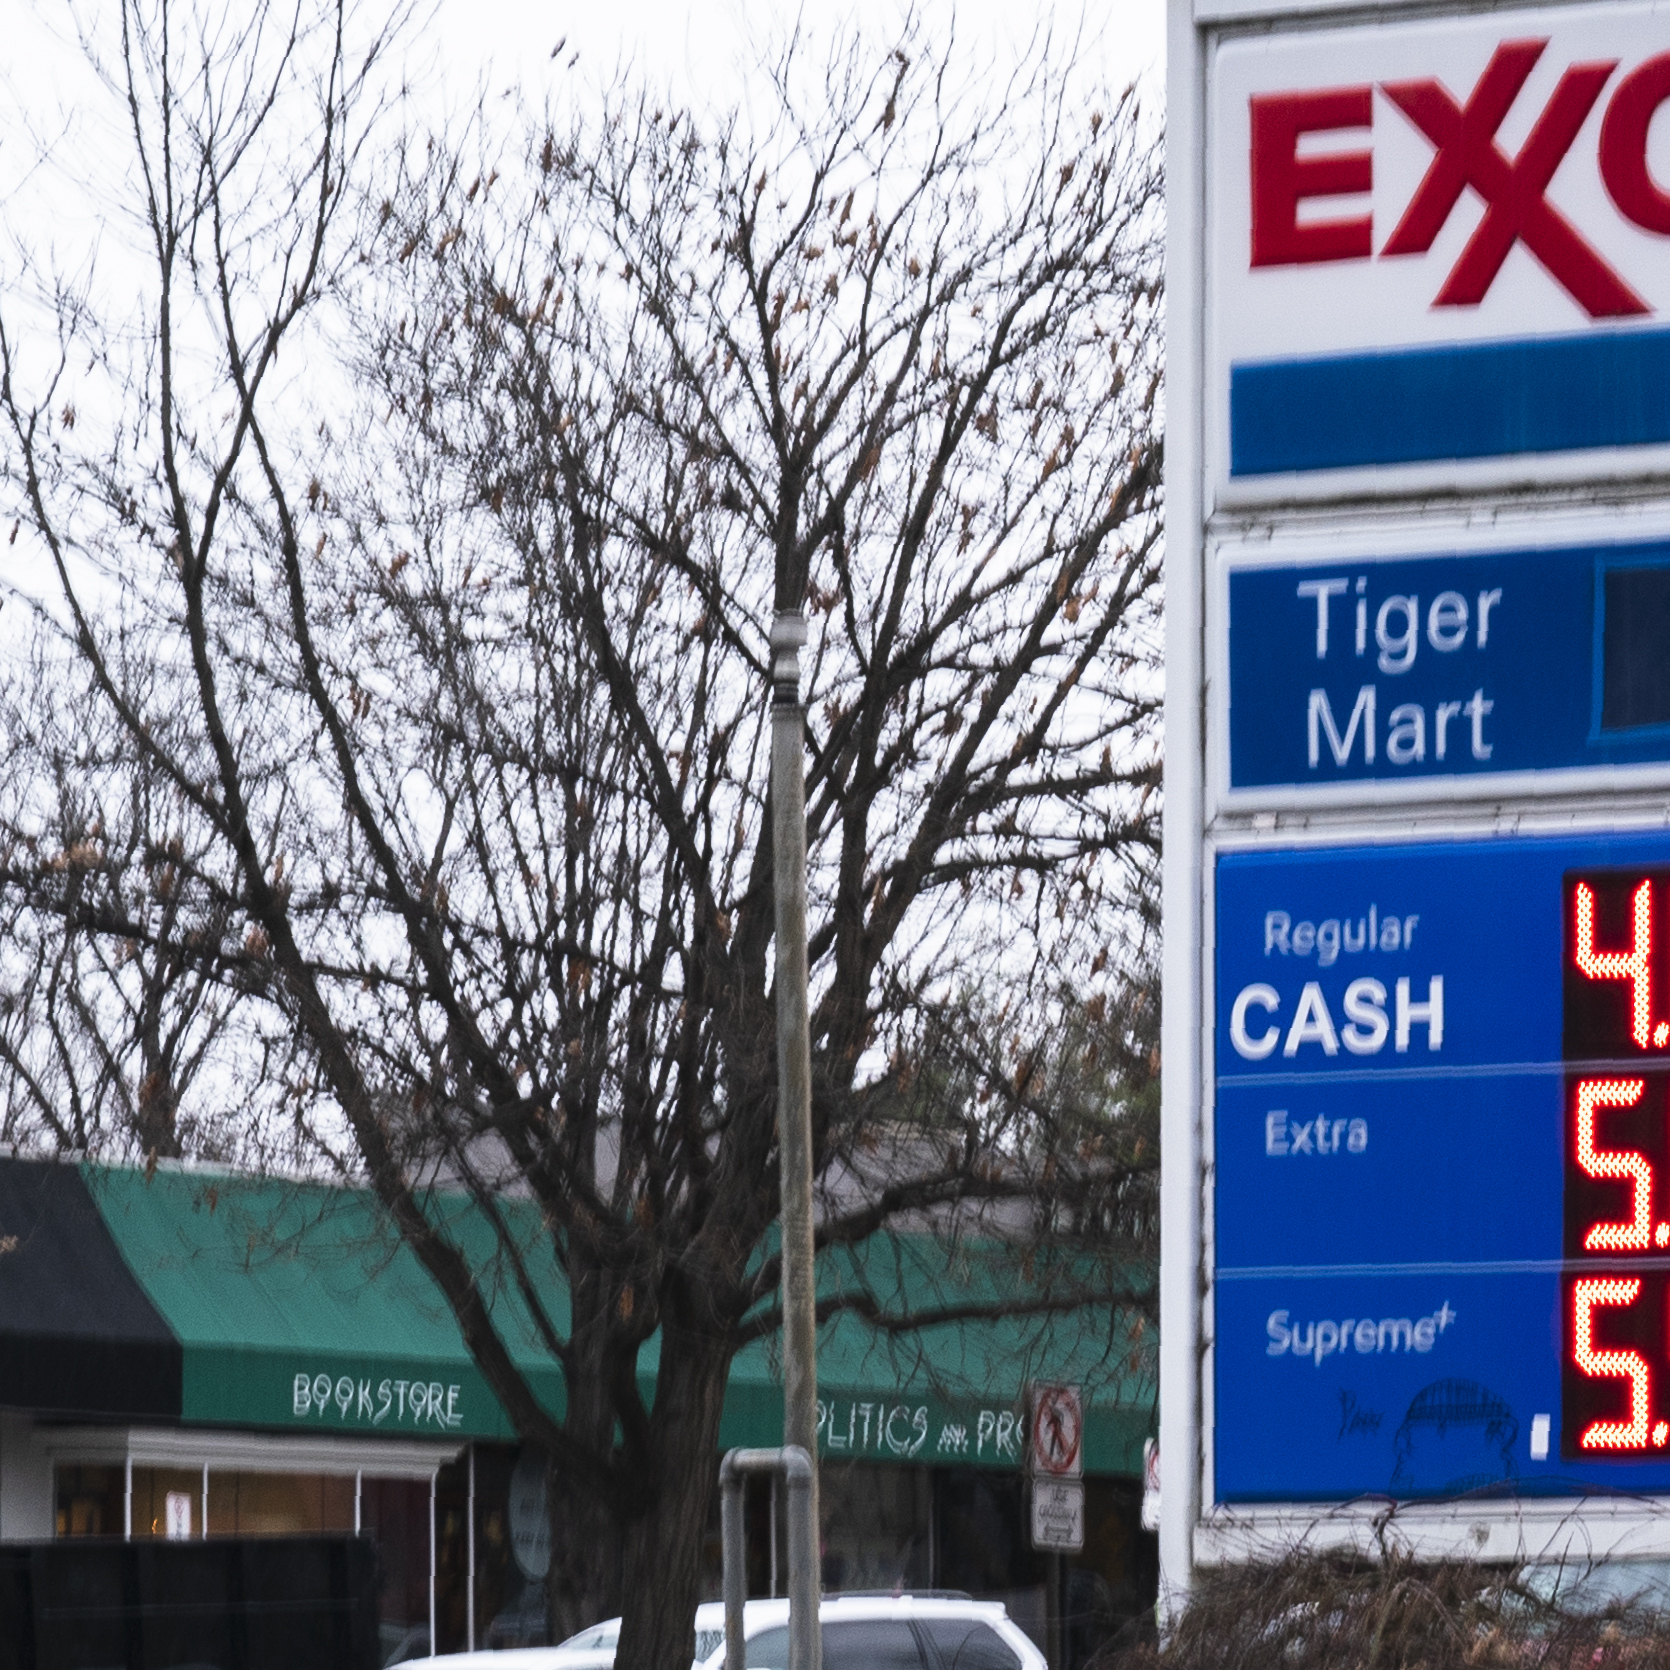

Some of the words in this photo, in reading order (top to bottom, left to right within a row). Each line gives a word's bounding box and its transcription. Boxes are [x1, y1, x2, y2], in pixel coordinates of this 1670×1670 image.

[1297, 576, 1503, 673] Tiger
[1307, 686, 1496, 770] Mart
[1264, 903, 1420, 966] Regular
[1229, 974, 1446, 1061] CASH
[1265, 1109, 1369, 1157] Extra
[293, 1373, 463, 1432] BOOKSTORE
